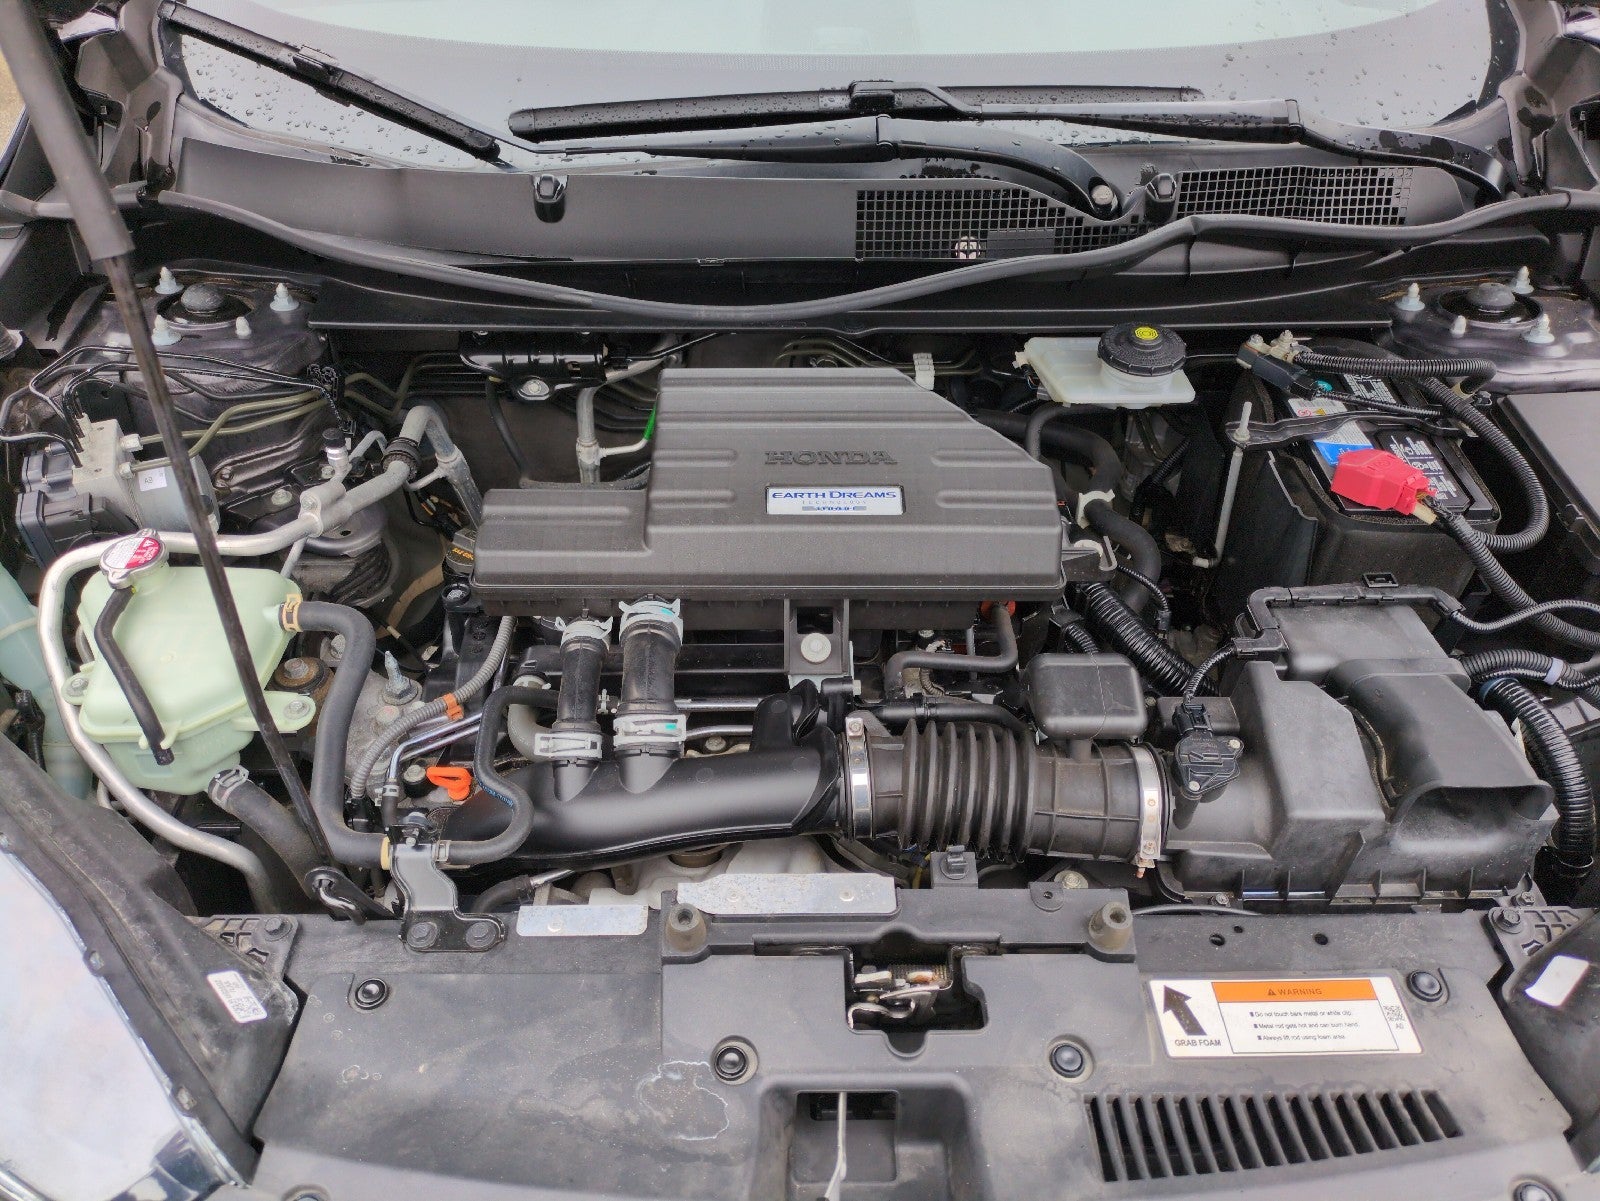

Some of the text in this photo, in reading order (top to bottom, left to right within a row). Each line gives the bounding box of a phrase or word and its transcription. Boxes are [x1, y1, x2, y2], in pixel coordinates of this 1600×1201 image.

[765, 450, 898, 465] HONDA
[772, 490, 897, 499] EARTH DREAMS
[1277, 988, 1323, 996] WARNING
[1174, 1039, 1222, 1047] GRAB FOAM
